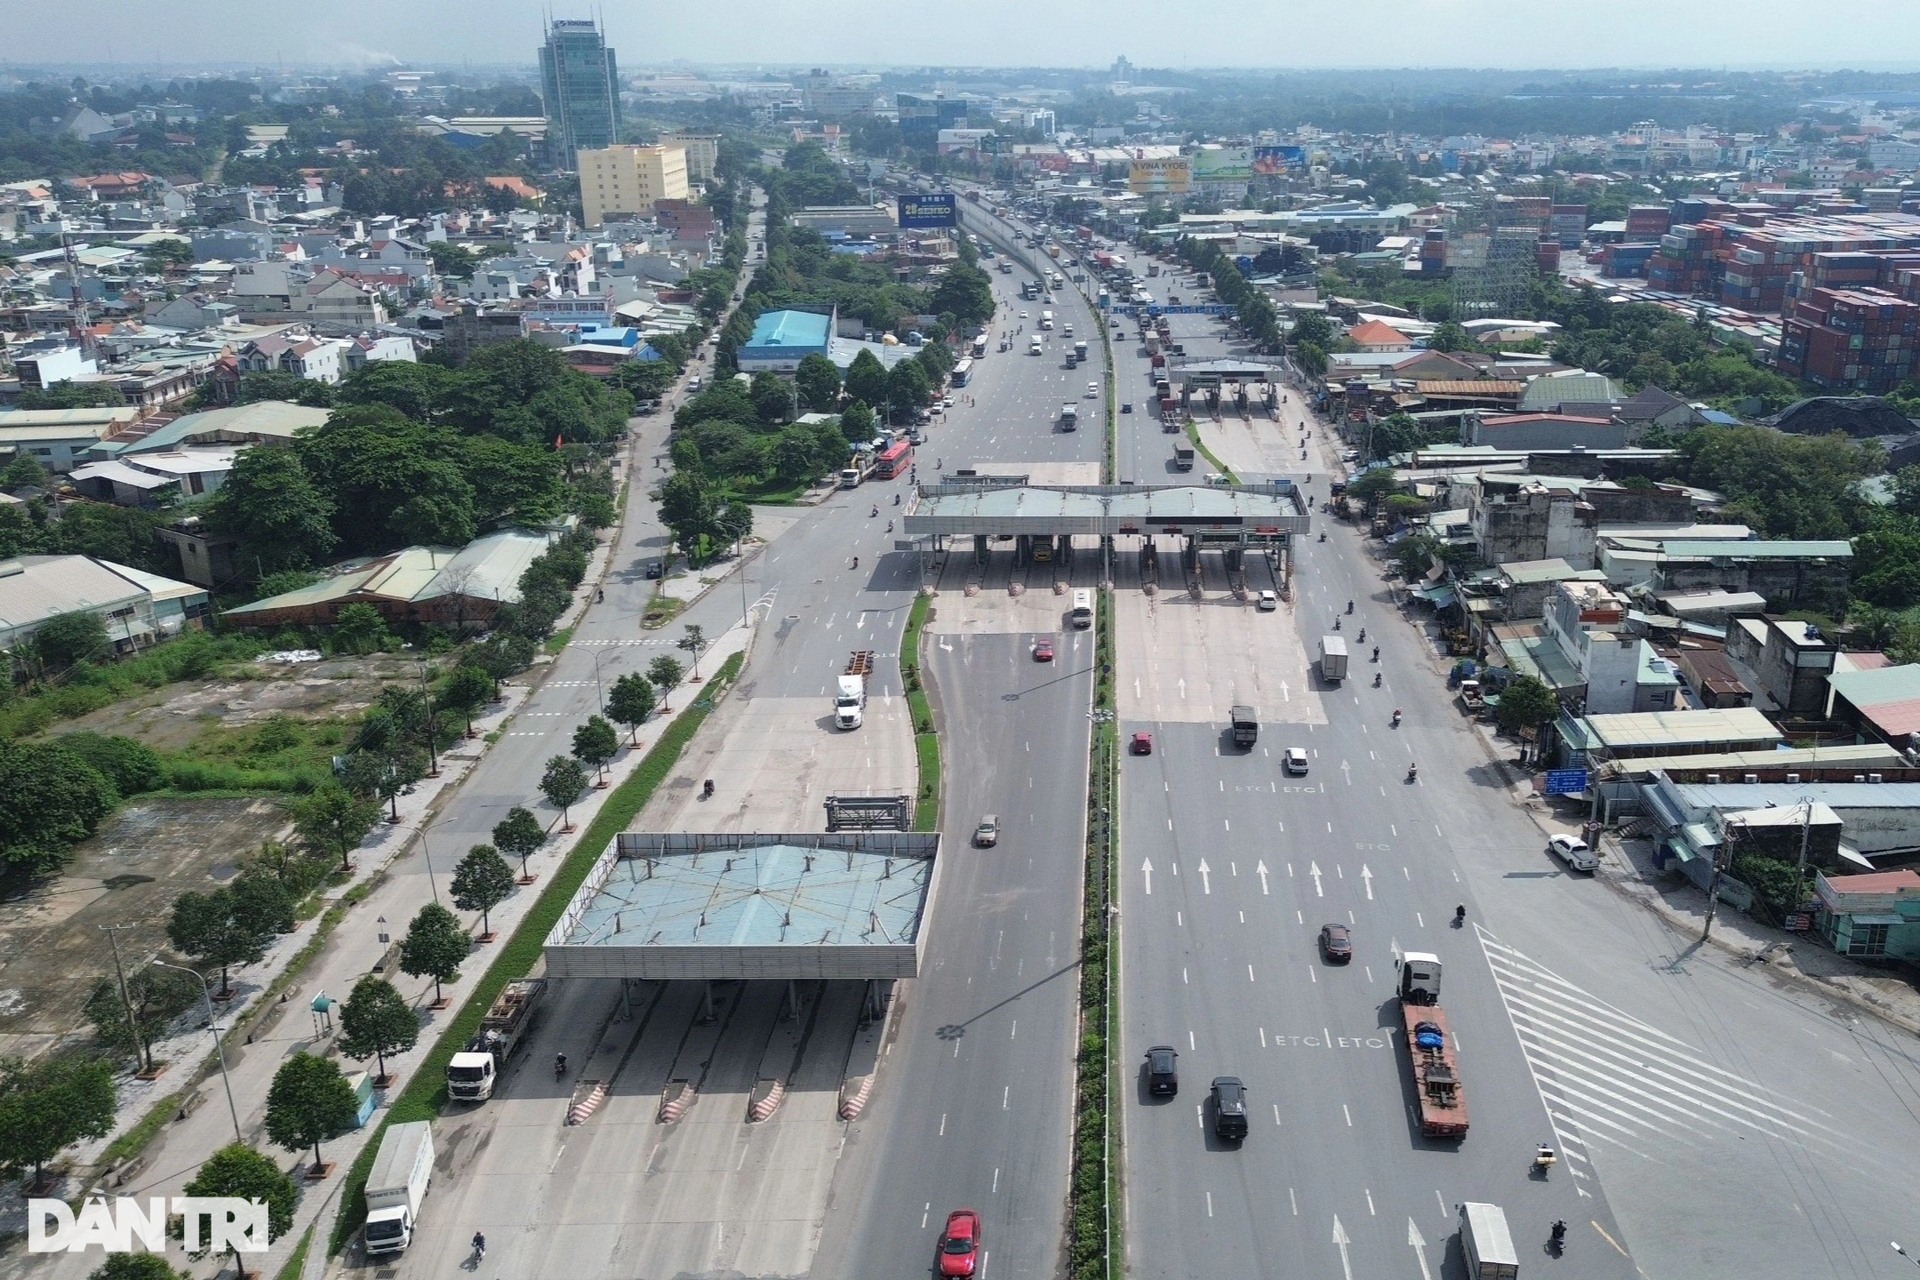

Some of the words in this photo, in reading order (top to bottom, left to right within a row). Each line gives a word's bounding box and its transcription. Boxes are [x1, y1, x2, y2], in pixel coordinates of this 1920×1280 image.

[1140, 162, 1160, 170] VINA
[1161, 162, 1188, 170] KYOEI
[918, 207, 951, 215] SENKO
[1356, 842, 1391, 851] ETC
[1275, 1035, 1321, 1047] ETC
[1338, 1036, 1384, 1049] ETC
